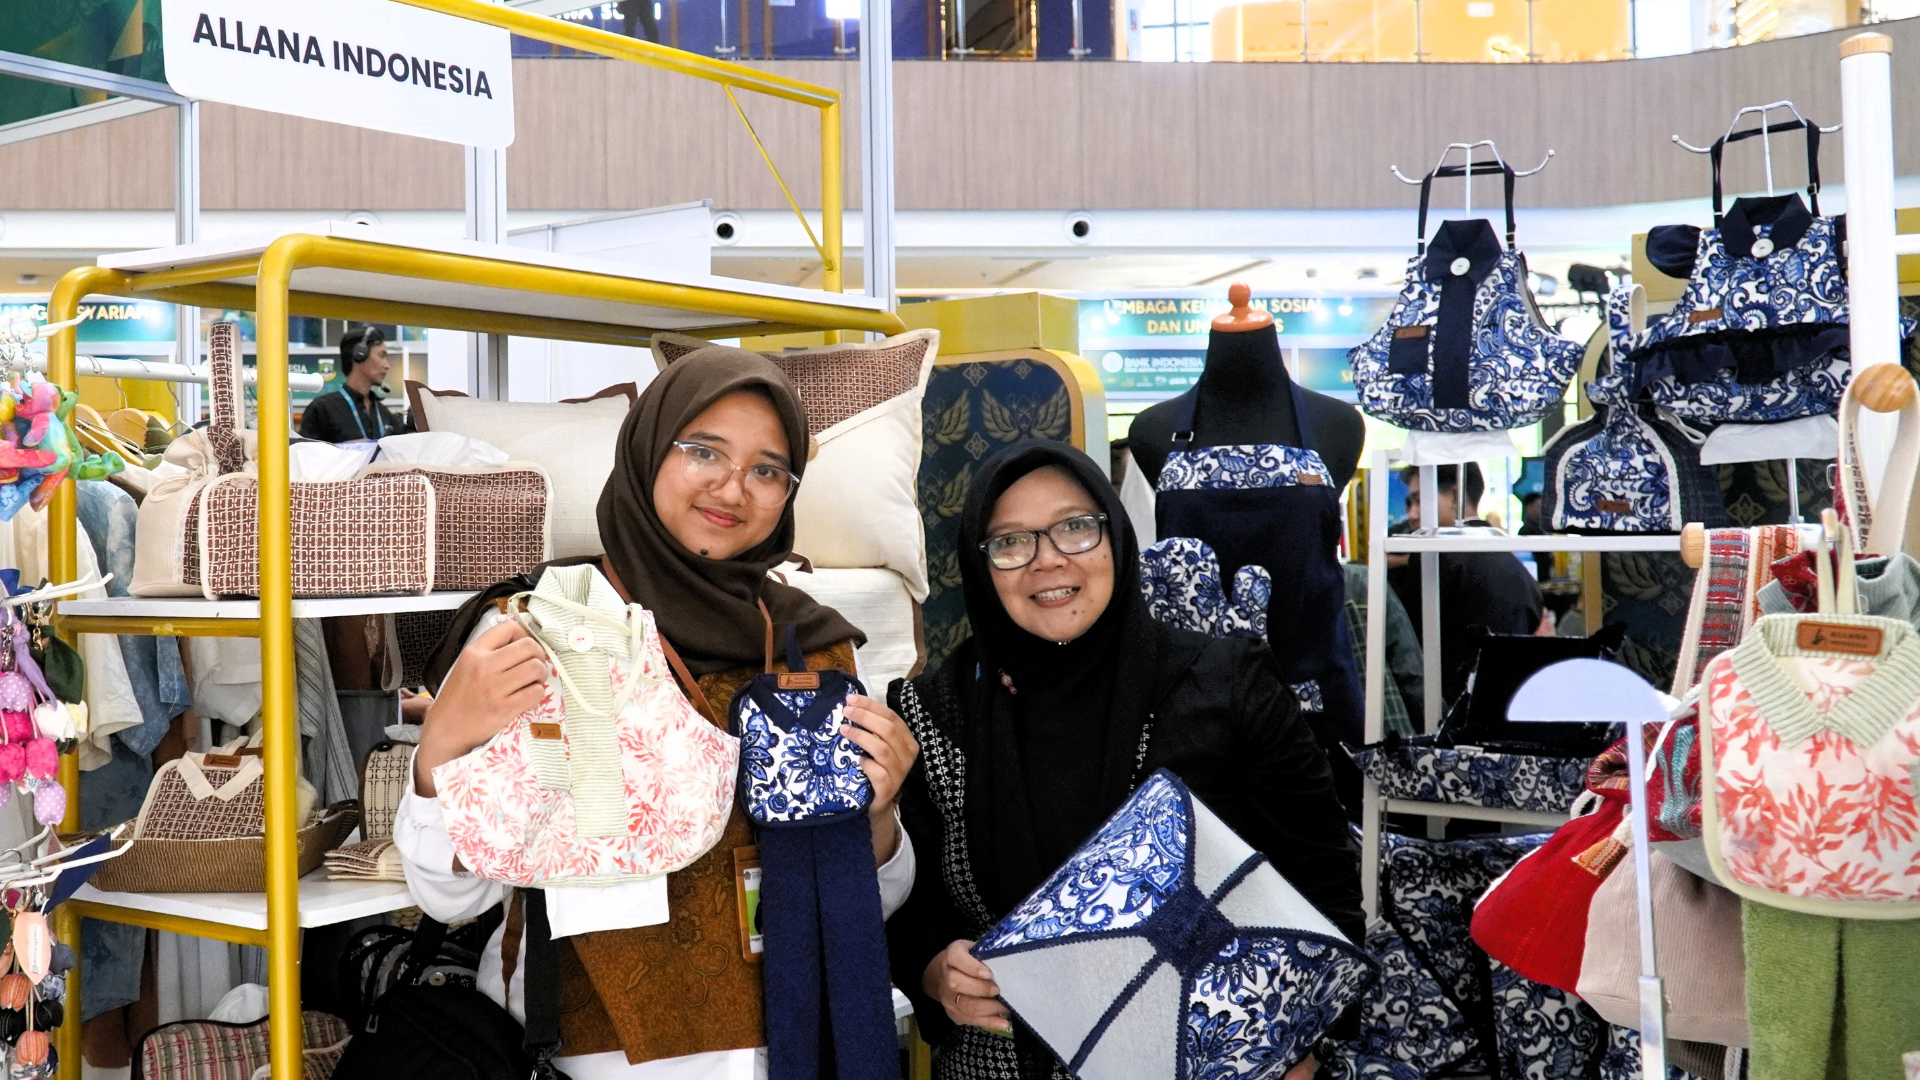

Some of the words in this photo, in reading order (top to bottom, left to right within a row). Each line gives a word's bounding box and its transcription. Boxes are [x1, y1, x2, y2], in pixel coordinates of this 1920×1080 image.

[193, 13, 325, 67] ALLANA
[333, 40, 493, 100] INDONESIA
[1147, 320, 1181, 334] DAN
[1124, 357, 1150, 367] BANK
[1151, 357, 1204, 368] INDONESIA
